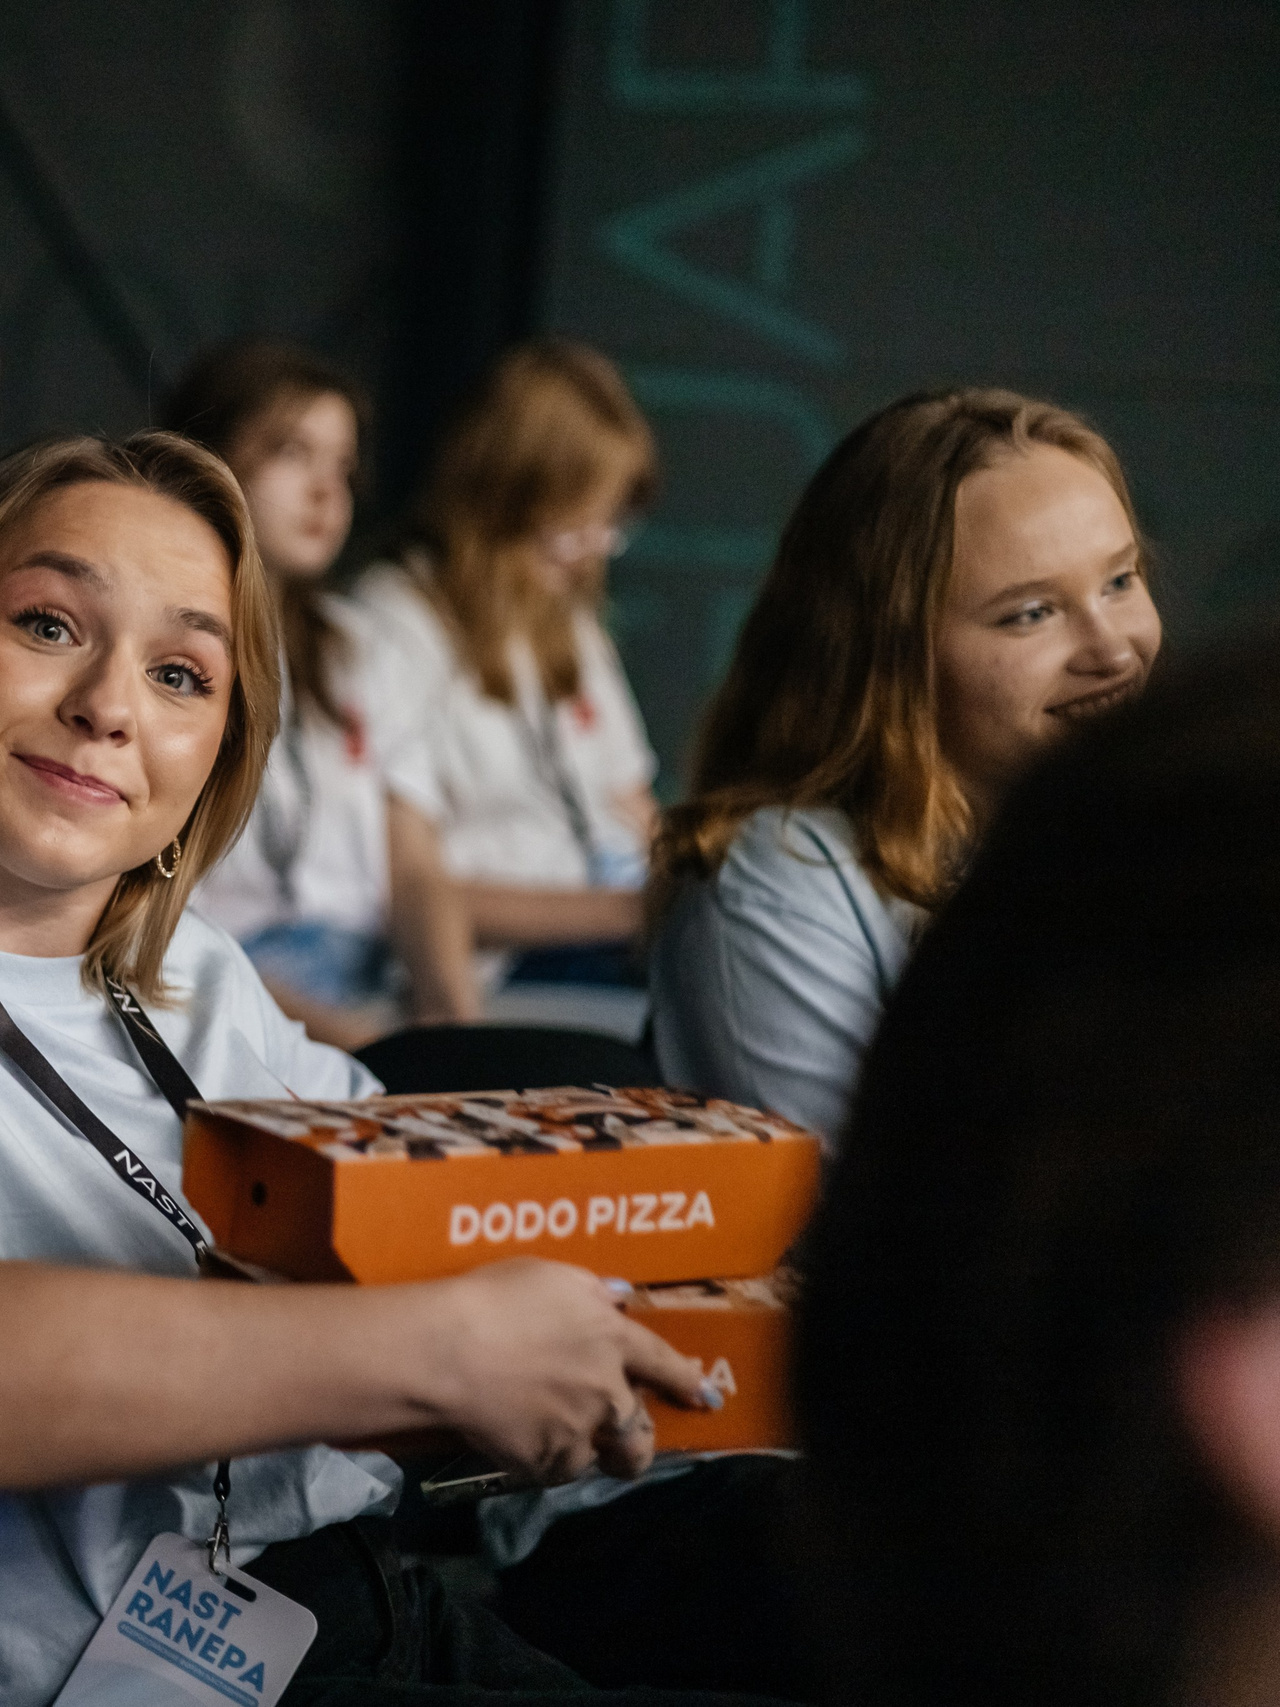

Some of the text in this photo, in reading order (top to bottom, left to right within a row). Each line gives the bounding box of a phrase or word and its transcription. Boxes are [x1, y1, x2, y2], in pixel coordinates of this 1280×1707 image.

[113, 1149, 195, 1228] NAST
[450, 1189, 716, 1246] DODO PIZZA
[143, 1560, 242, 1631] NAST
[125, 1589, 265, 1694] RANEPA
